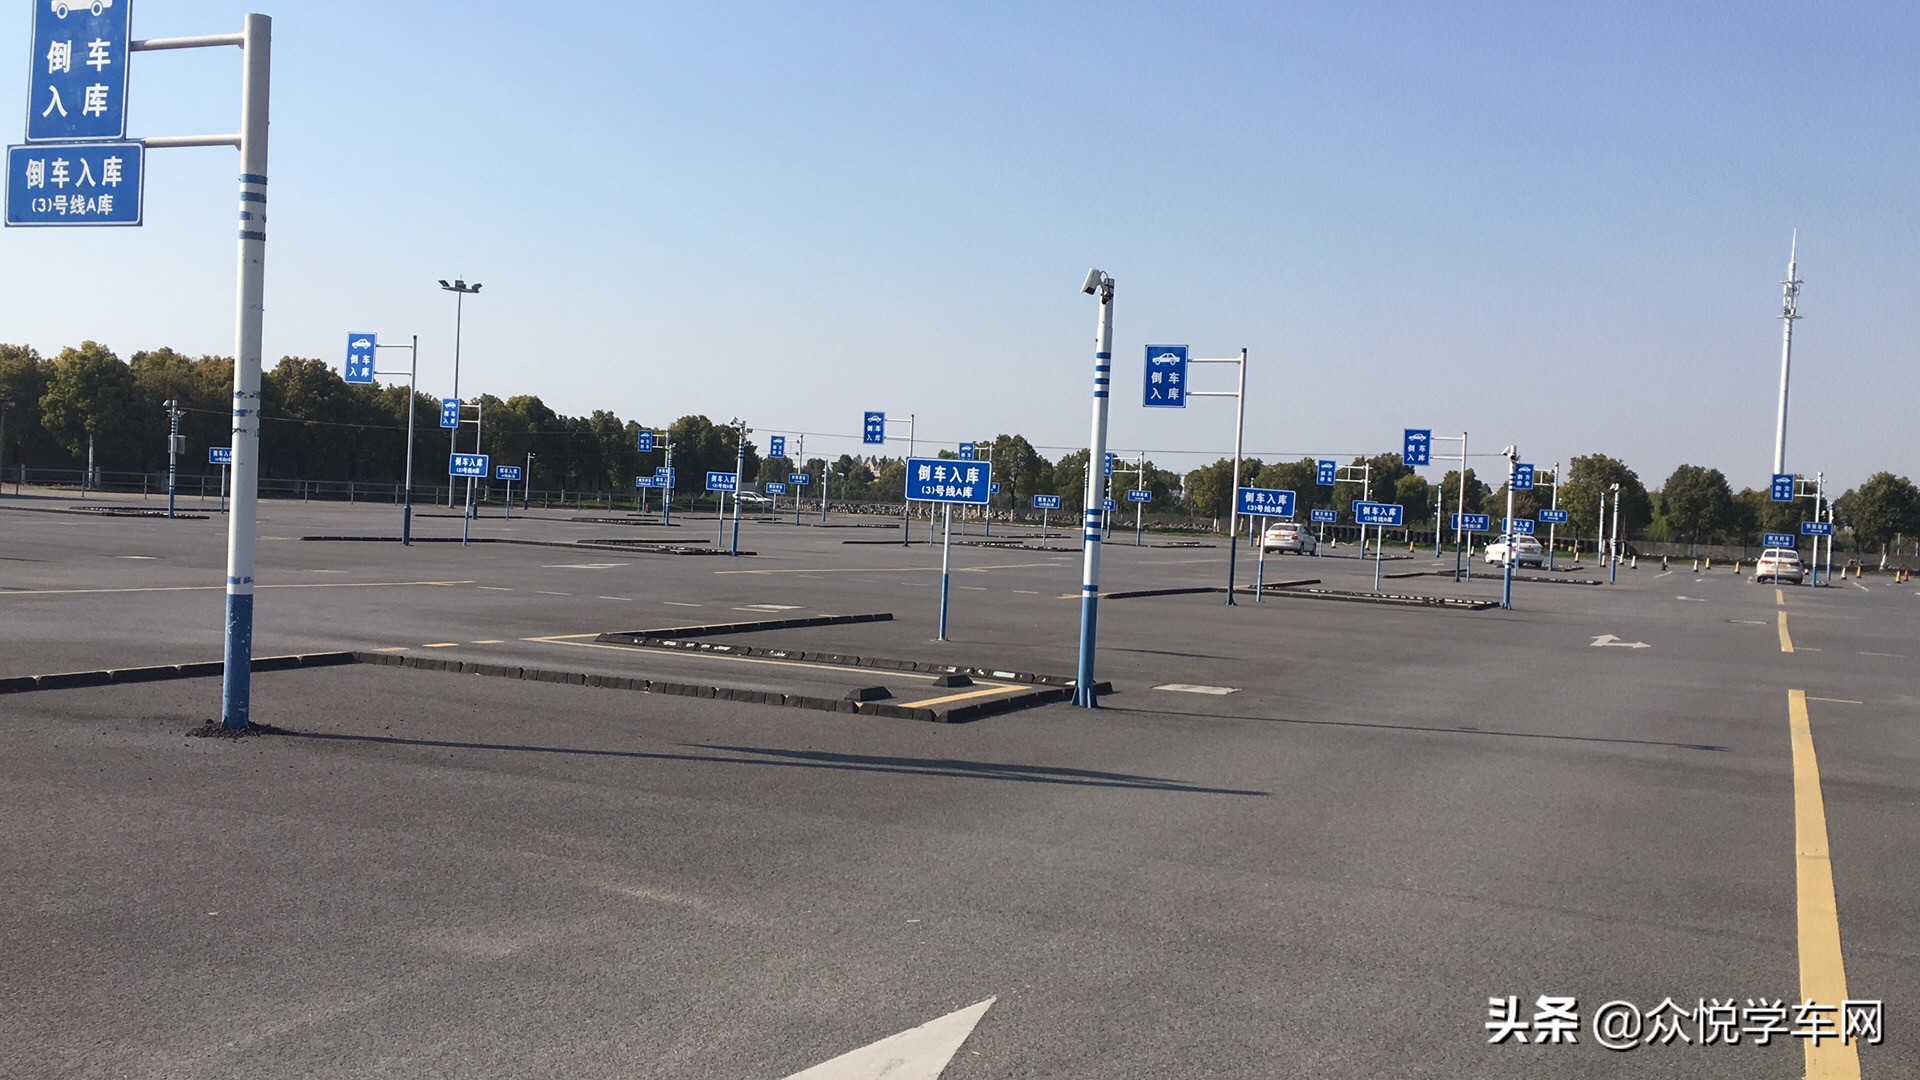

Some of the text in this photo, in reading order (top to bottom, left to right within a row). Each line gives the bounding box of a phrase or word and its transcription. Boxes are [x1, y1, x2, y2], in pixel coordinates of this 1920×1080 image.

[46, 37, 111, 74] 倒车
[42, 82, 110, 118] 入库
[25, 156, 123, 189] 倒车入库
[32, 194, 114, 216] (3)号线A库
[350, 354, 371, 365] 倒车
[349, 367, 370, 377] 入库
[1151, 371, 1180, 385] 倒车
[1150, 387, 1180, 400] 入库
[917, 464, 980, 485] 倒车入库
[921, 485, 974, 499] (3)号线A库
[1245, 492, 1288, 506] 倒车入库
[1363, 506, 1397, 516] 倒车入库
